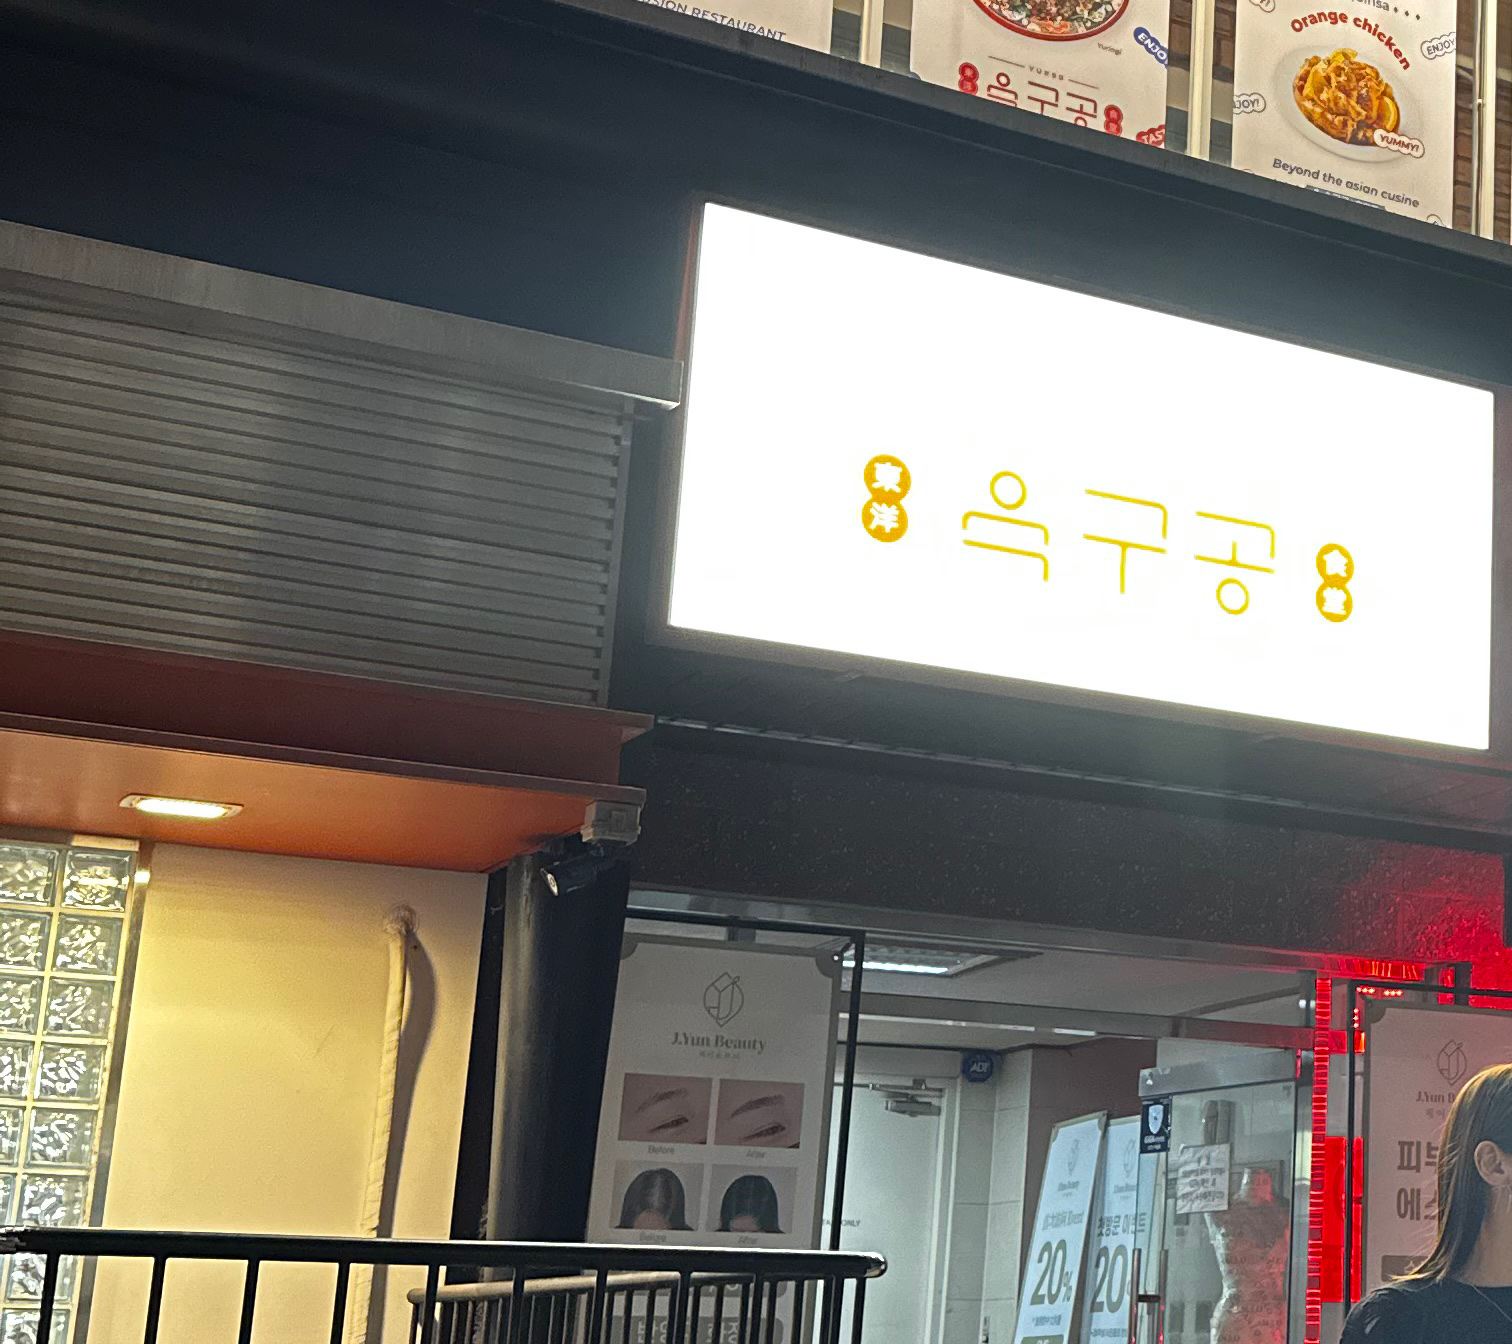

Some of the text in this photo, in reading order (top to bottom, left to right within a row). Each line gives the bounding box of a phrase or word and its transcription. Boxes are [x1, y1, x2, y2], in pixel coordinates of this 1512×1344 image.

[691, 6, 787, 42] RESTAURANT
[1290, 10, 1412, 71] Orange chicken
[1379, 132, 1421, 153] YUMMY!
[1272, 157, 1321, 181] Beyond
[1322, 172, 1343, 187] the
[1345, 179, 1379, 197] asian
[1380, 190, 1421, 209] cusine
[961, 470, 1277, 616] 육구공
[671, 1031, 710, 1047] J.Yun
[714, 1034, 768, 1056] Beauty
[970, 1061, 989, 1073] ADT
[1030, 1238, 1074, 1306] 20%
[1090, 1243, 1130, 1314] 20
